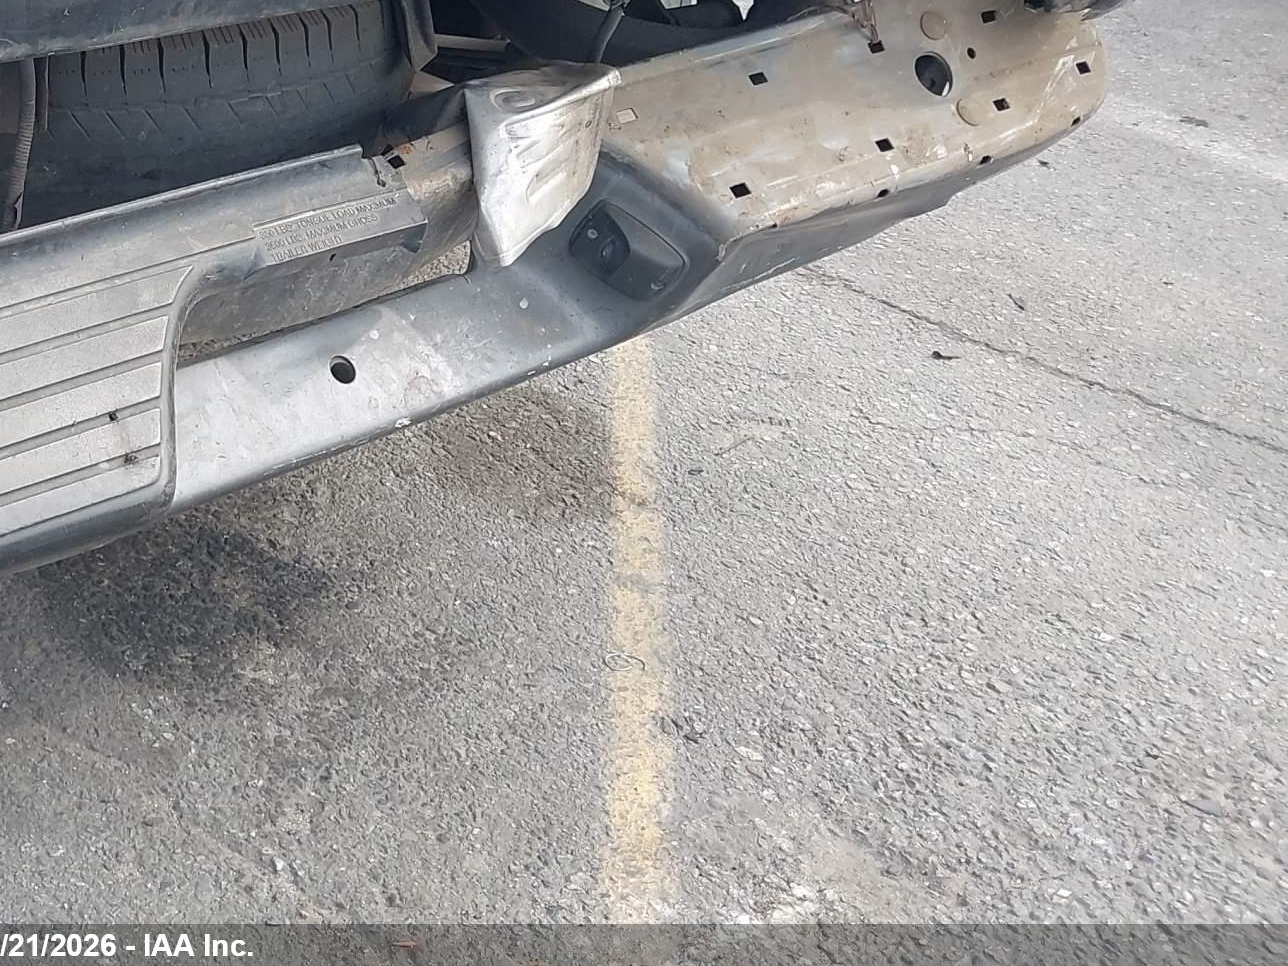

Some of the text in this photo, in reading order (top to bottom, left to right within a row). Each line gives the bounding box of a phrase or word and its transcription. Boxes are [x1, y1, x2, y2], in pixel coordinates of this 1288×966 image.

[296, 213, 332, 229] TONGUE
[332, 207, 356, 221] LOAD
[356, 197, 397, 214] MAXIMUM
[305, 221, 347, 240] MAXIMUM
[348, 214, 379, 228] GROSS
[272, 234, 343, 263] TRAILER WEIGHT
